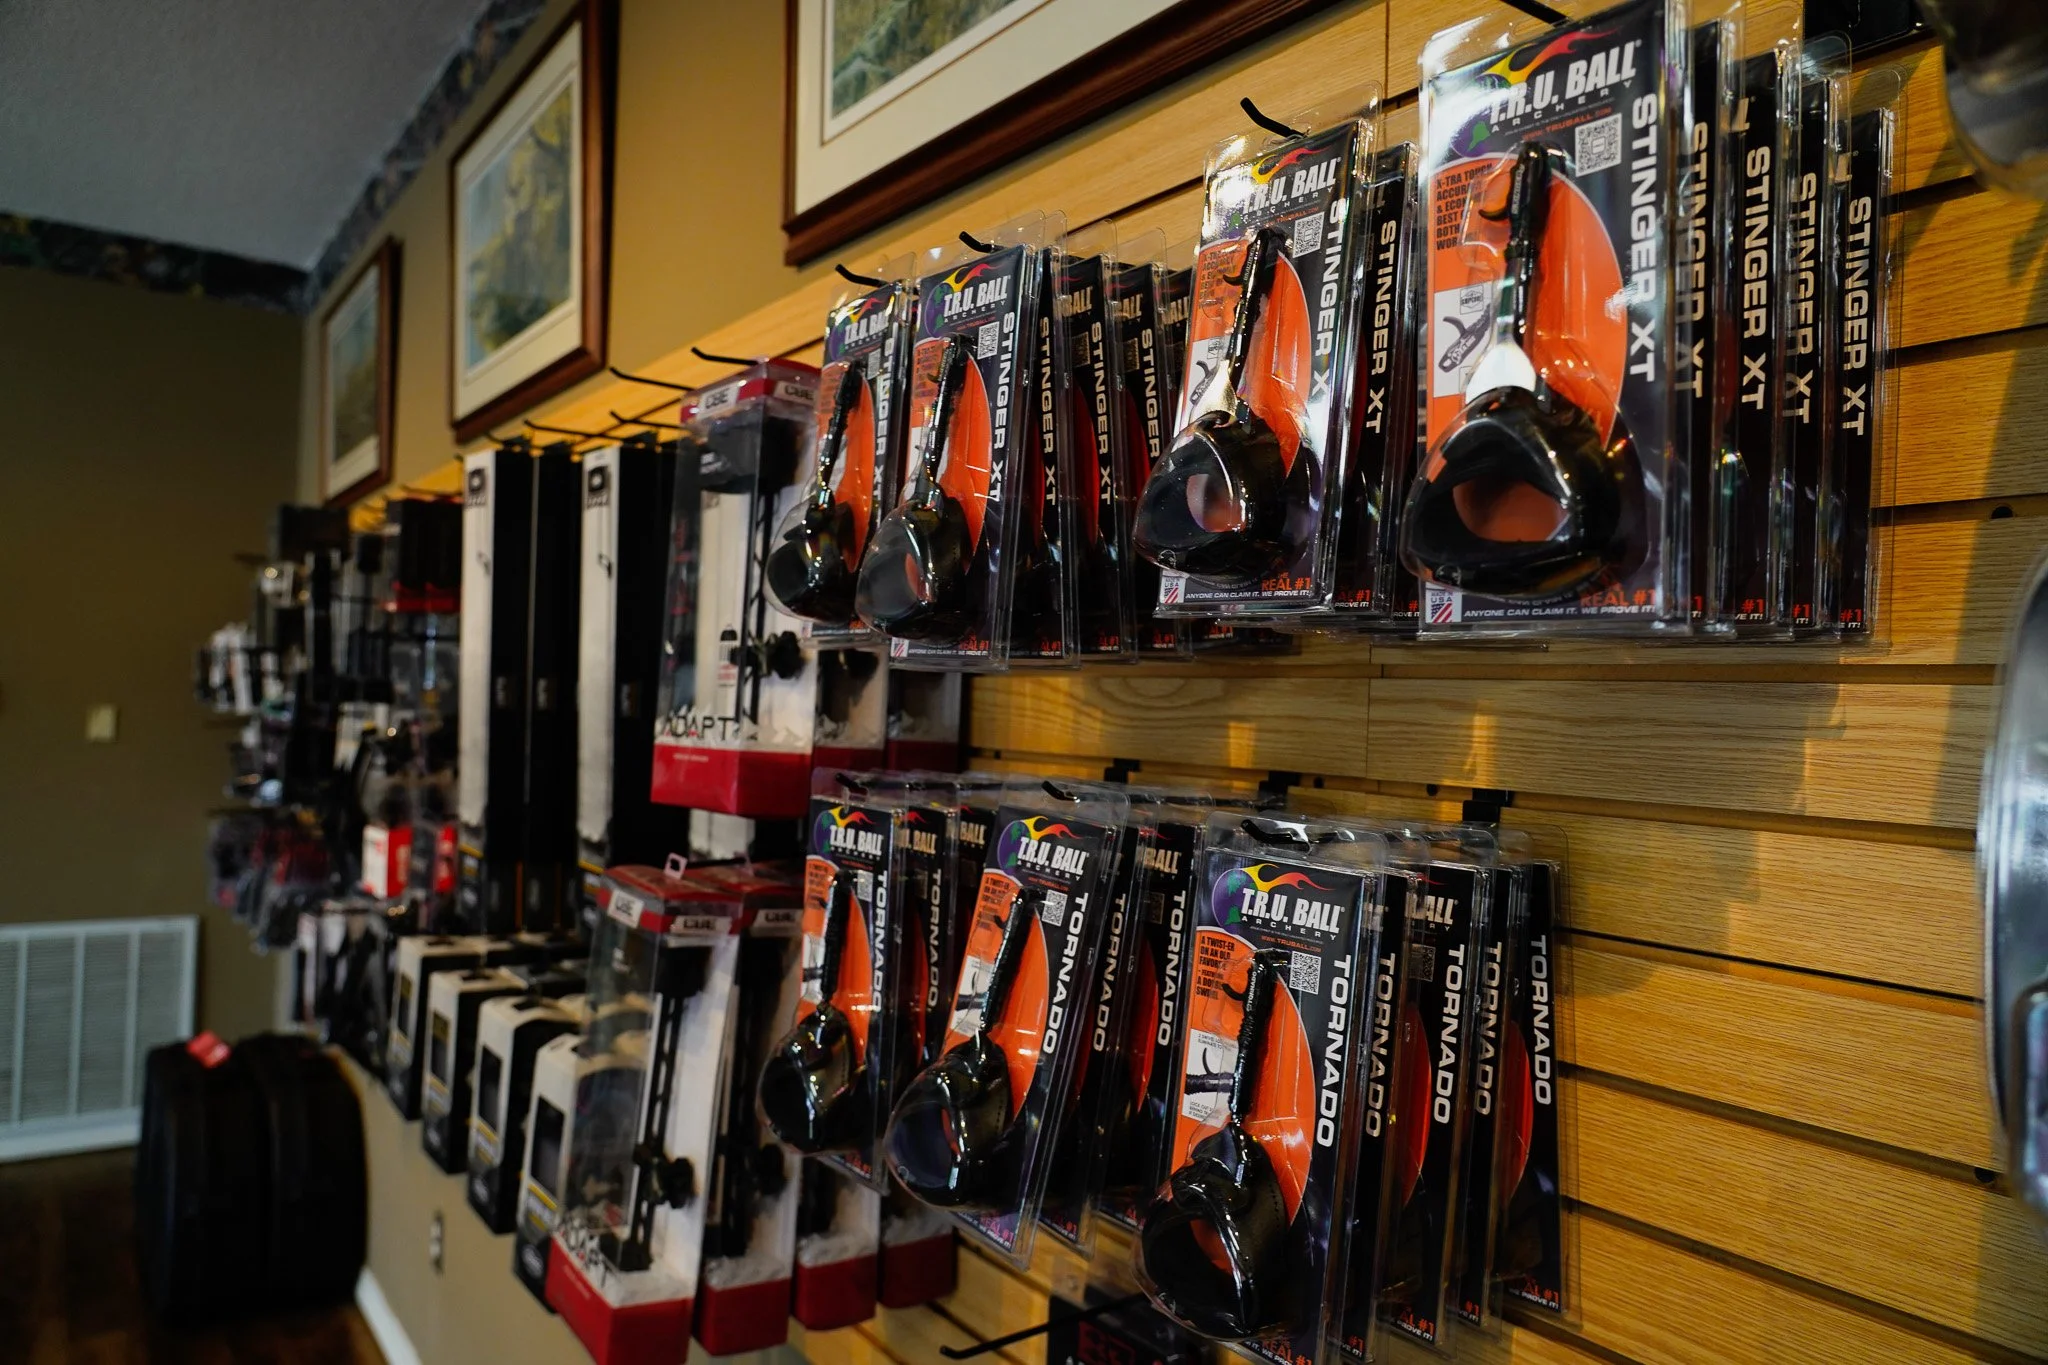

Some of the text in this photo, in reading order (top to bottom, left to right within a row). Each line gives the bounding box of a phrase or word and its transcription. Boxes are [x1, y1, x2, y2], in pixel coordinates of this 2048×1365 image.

[1492, 79, 1632, 133] ARCHERY
[1565, 41, 1636, 99] BALL
[1291, 158, 1336, 199] BALL
[1630, 92, 1658, 382] STINGER XT
[944, 275, 1008, 317] T.R.U. BALL
[1315, 198, 1346, 357] STINGER
[1372, 220, 1396, 376] STINGER
[1741, 146, 1771, 410] STINGER XT
[1783, 172, 1817, 423] STINGER XT
[1842, 196, 1872, 436] STINGER XT
[989, 311, 1015, 502] STINGER XT
[1040, 317, 1056, 506] STINGER XT
[1091, 322, 1111, 505] STINGER XT
[1142, 328, 1160, 458] STINGER
[1366, 387, 1385, 434] XT
[1261, 578, 1293, 591] REAL
[1295, 577, 1311, 590] #1
[1356, 589, 1370, 601] #1
[1464, 609, 1504, 617] ANYONE
[1506, 608, 1528, 616] CAN
[1531, 607, 1564, 615] CLAIM
[1600, 605, 1639, 614] PROVE
[1742, 598, 1764, 613] #1
[1840, 608, 1862, 622] #1
[829, 825, 856, 849] T.R.U.
[857, 830, 884, 857] BALL
[913, 829, 938, 855] BALL
[960, 821, 987, 845] BALL
[1017, 836, 1087, 876] T.R.U. BALL
[872, 870, 887, 1012] TORNADO
[927, 868, 941, 1007] TORNADO
[1042, 892, 1089, 1054] TORNADO
[1093, 893, 1126, 1052] TORNADO
[1157, 890, 1186, 1046] TORNADO
[1241, 888, 1289, 923] T.R.U.
[1292, 898, 1341, 934] BALL
[1242, 916, 1339, 941] ARCHERY
[1317, 954, 1351, 1147] TORNADO
[1366, 953, 1395, 1137] TORNADO
[1434, 944, 1464, 1124] TORNADO
[1475, 941, 1502, 1116] TORNADO
[1531, 935, 1551, 1105] TORNADO
[1418, 1319, 1434, 1335] #1
[1543, 1284, 1560, 1301] #1
